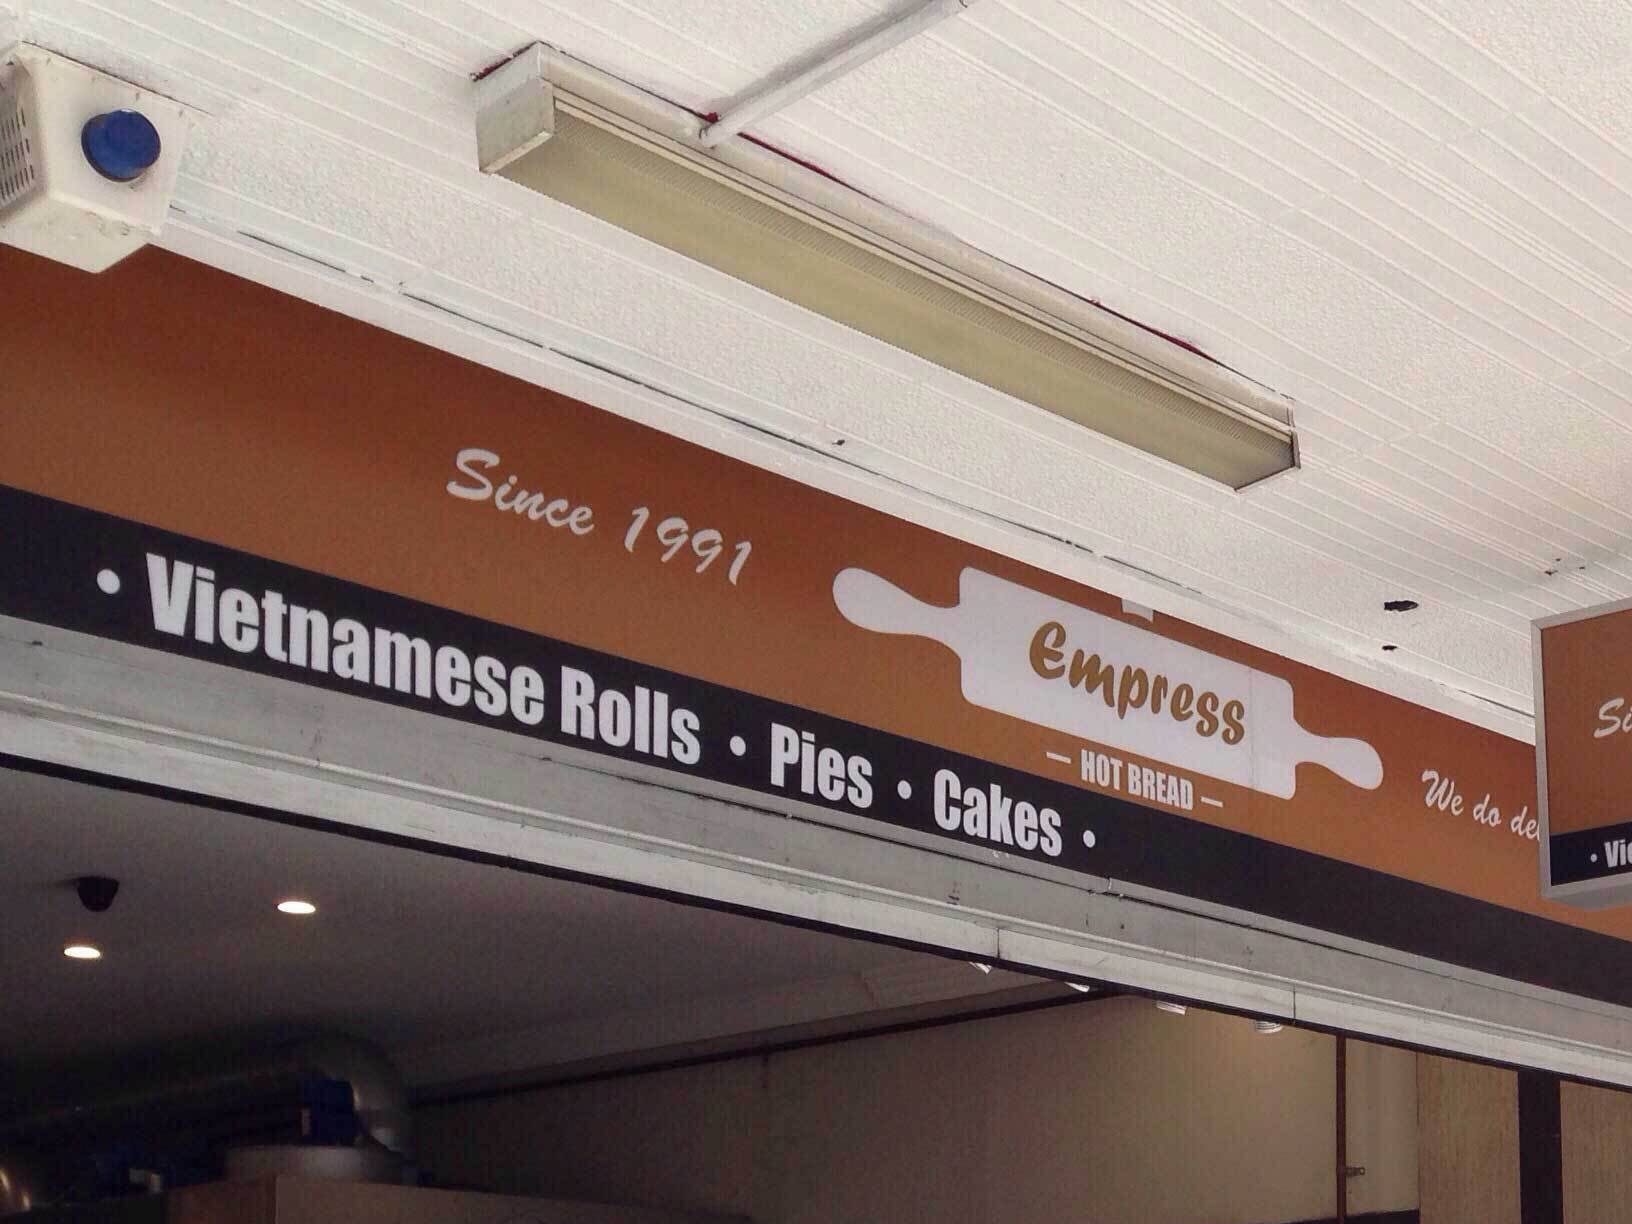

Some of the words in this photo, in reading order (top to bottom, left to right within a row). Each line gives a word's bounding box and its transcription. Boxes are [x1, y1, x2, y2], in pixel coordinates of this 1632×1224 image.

[446, 448, 595, 536] Since
[624, 507, 754, 585] 1991
[145, 552, 545, 726] Vietnamese
[560, 665, 702, 765] Rolls
[770, 722, 873, 809] Pies
[933, 768, 1062, 857] Cakes
[1030, 621, 1246, 745] Empress
[1080, 748, 1124, 796] HOT
[1128, 760, 1194, 810] BREAD
[1421, 769, 1464, 816] We
[1473, 793, 1502, 827] do
